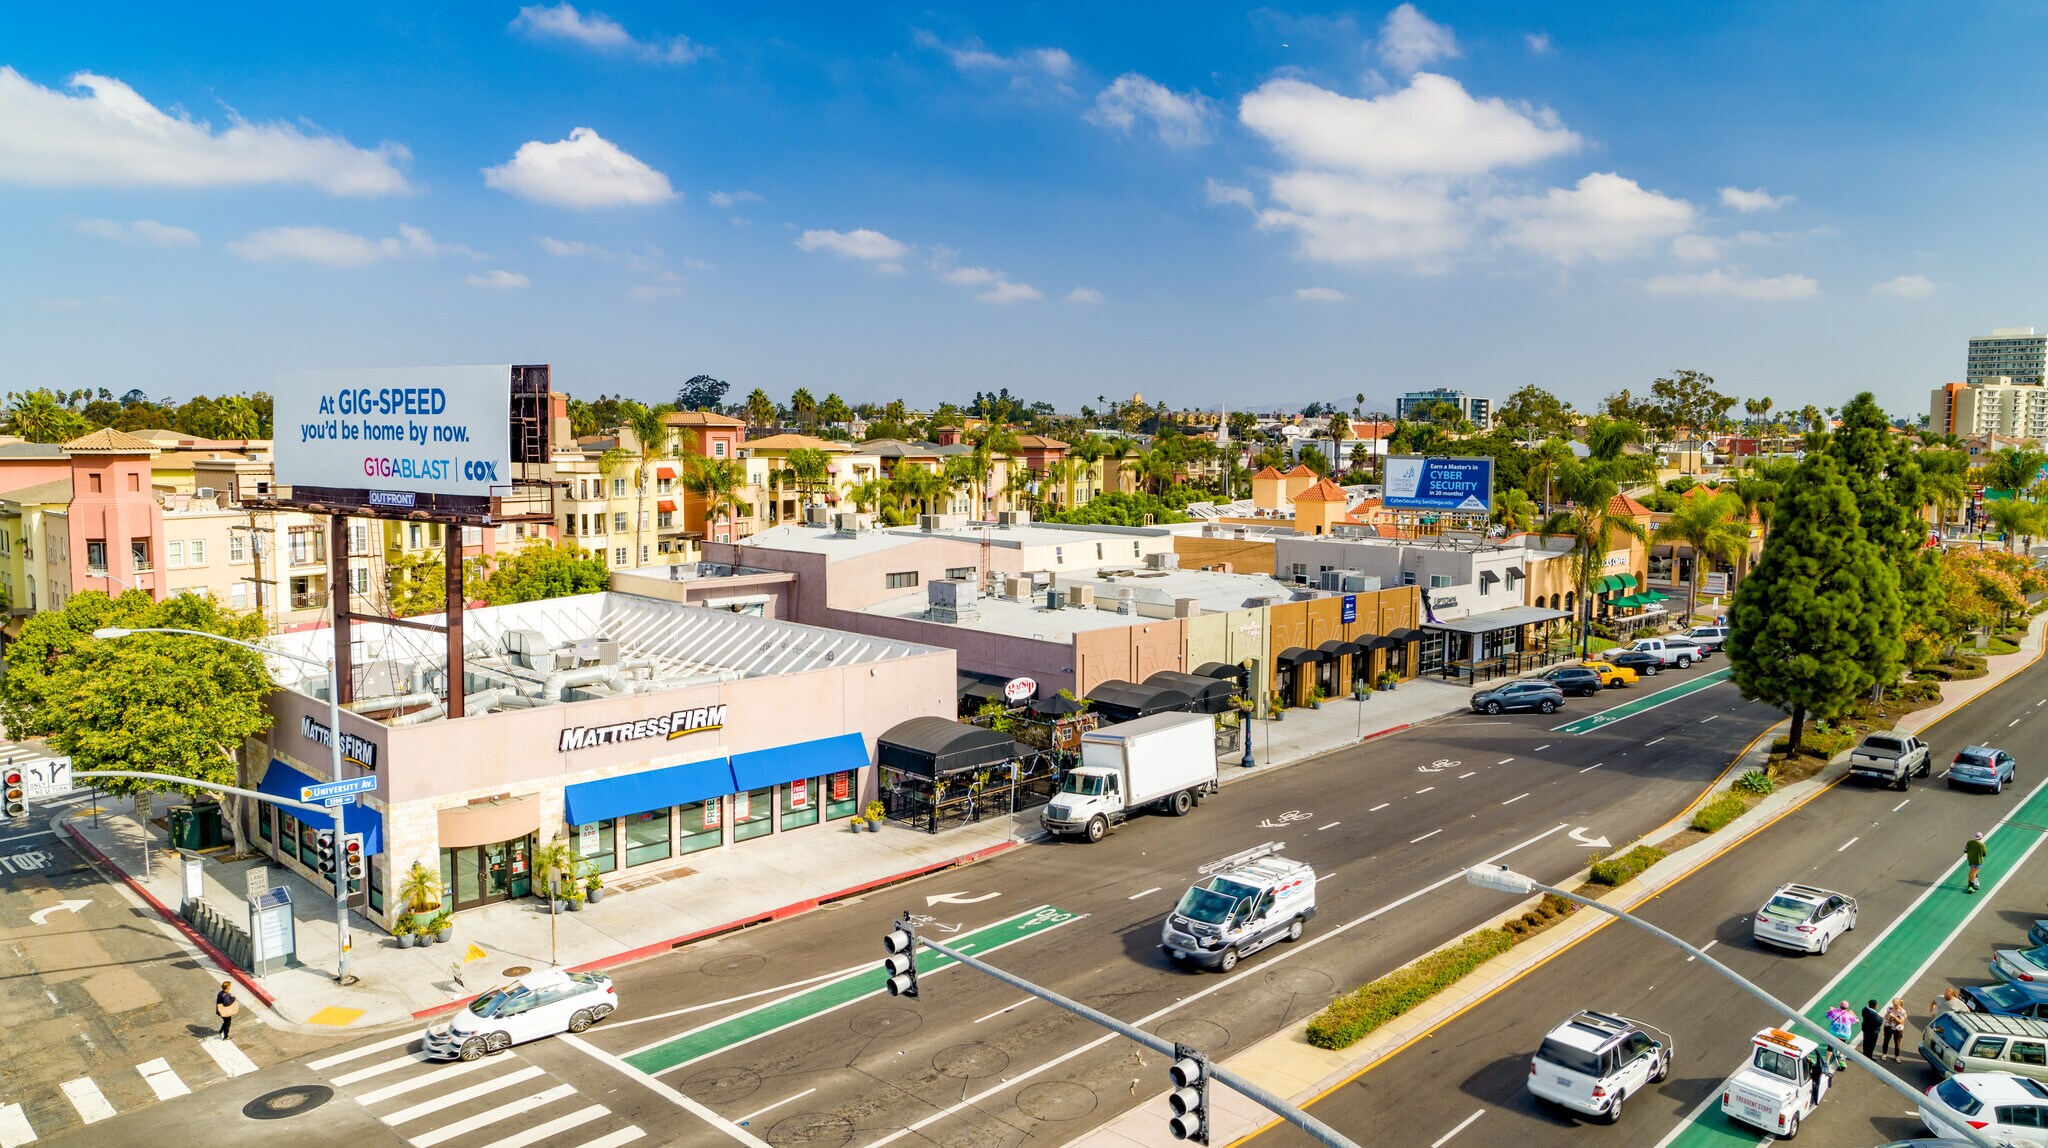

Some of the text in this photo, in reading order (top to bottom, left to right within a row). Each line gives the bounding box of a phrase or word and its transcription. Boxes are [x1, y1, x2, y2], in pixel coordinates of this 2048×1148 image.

[319, 388, 446, 414] At GIG-SPEED
[301, 420, 470, 446] you'd be home by now.
[464, 458, 499, 484] COX
[1430, 470, 1462, 480] CYBER
[1430, 481, 1478, 490] SECURITY
[371, 494, 413, 506] OUTFRONT
[302, 716, 373, 766] MATTRSFIRM
[314, 782, 358, 796] UNIVERSITY
[706, 799, 715, 824] FREE
[0, 851, 46, 876] TOP
